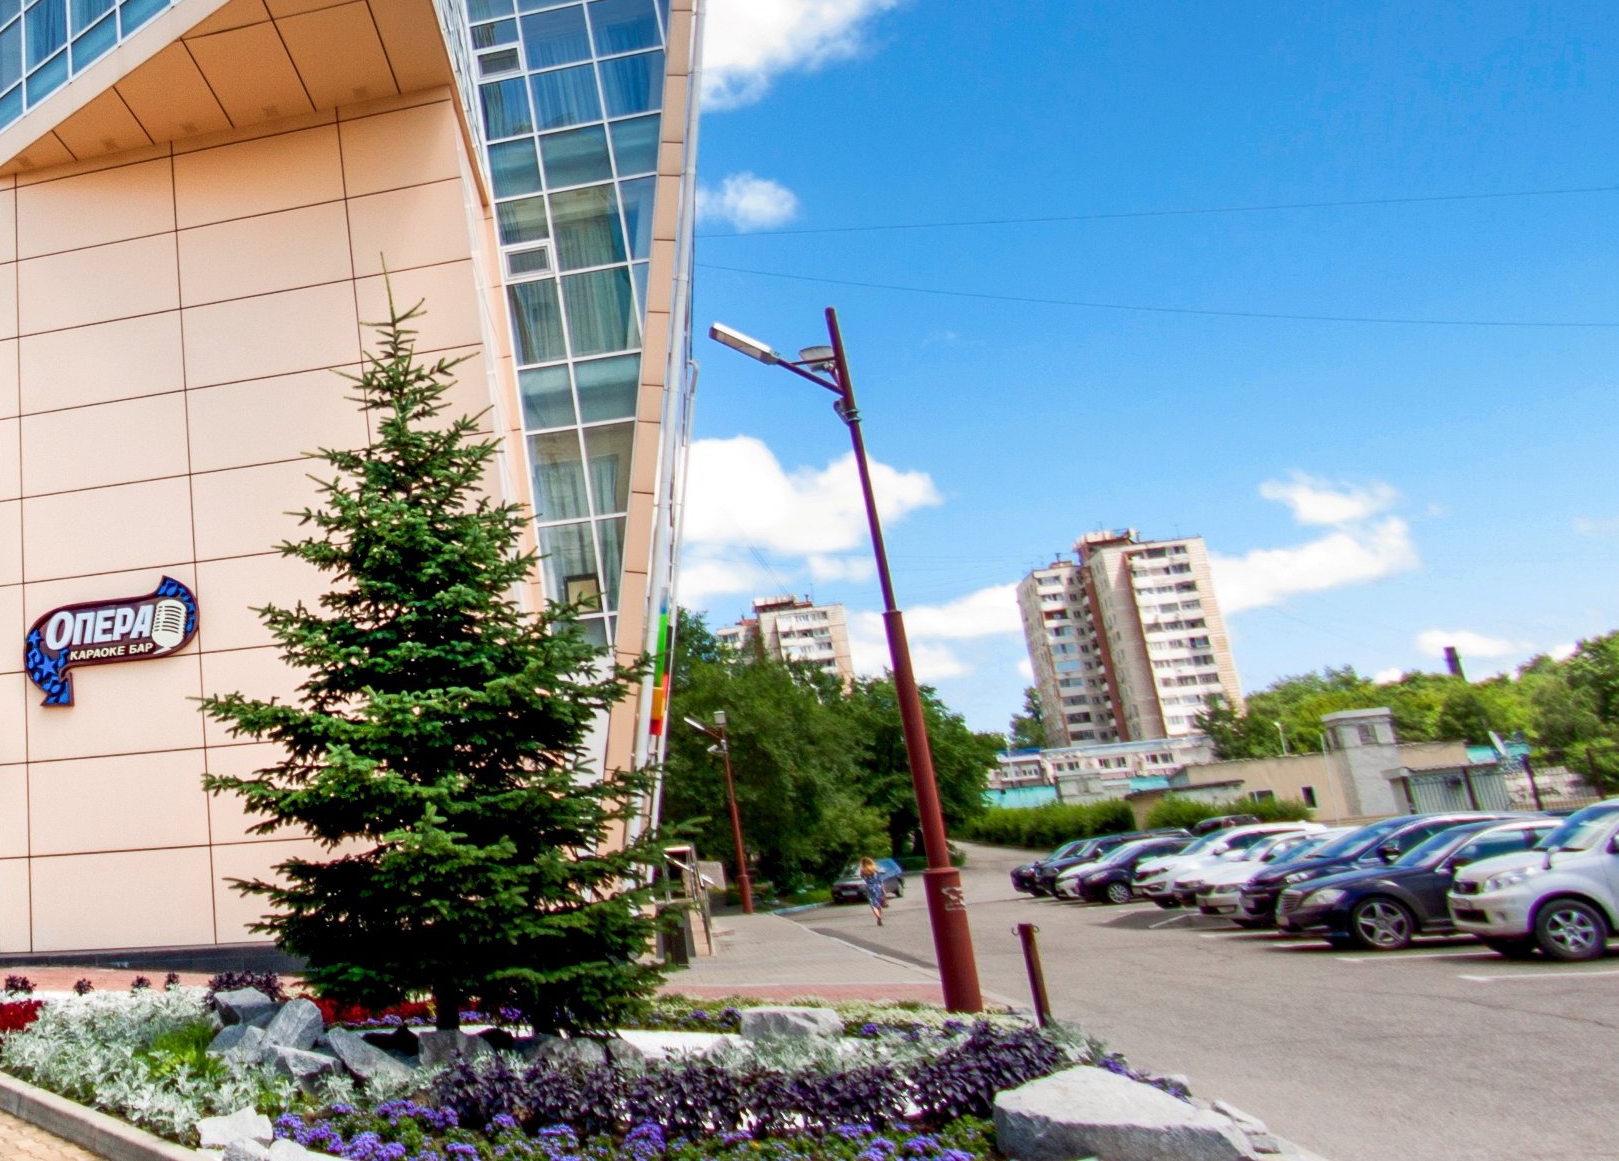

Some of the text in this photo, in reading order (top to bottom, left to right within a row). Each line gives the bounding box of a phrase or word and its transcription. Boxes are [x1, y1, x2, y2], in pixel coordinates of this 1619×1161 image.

[45, 604, 154, 650] ОПЕРА
[69, 642, 154, 661] КАРАОКЕ БАР
